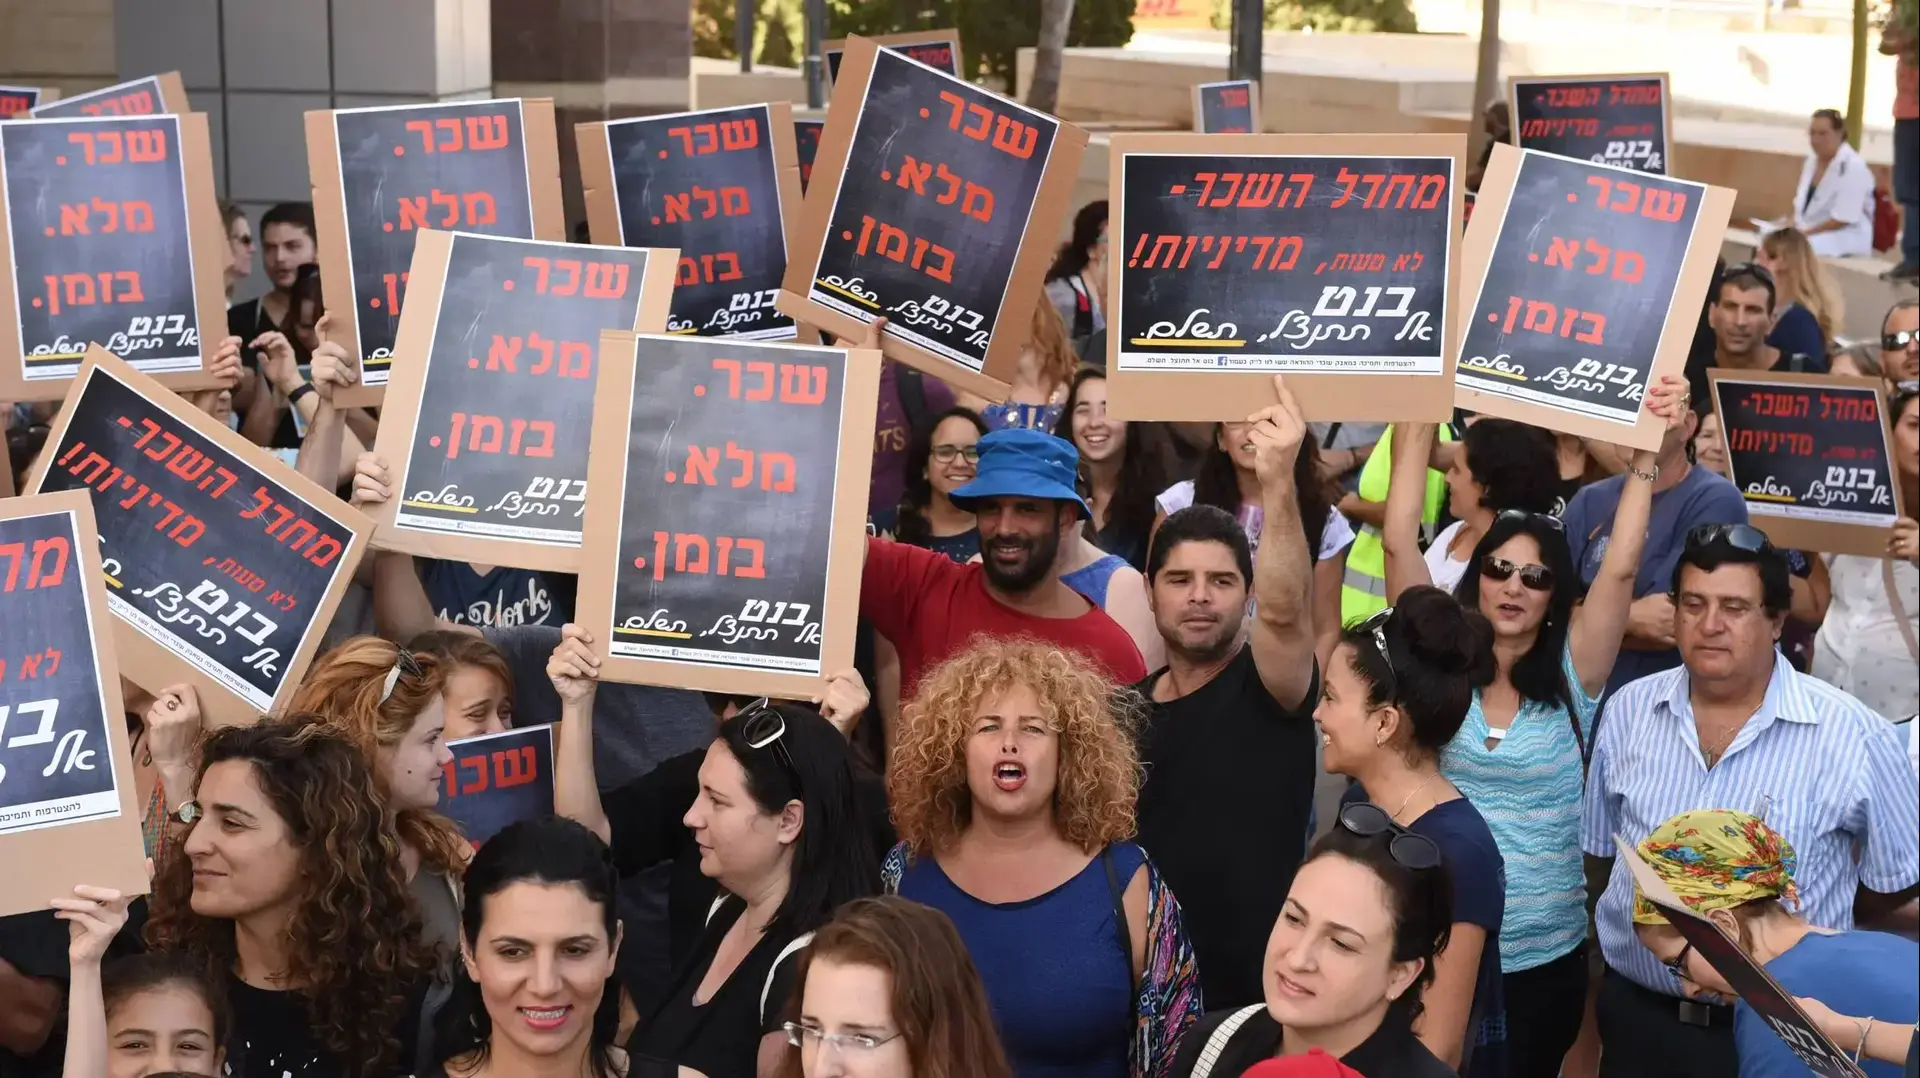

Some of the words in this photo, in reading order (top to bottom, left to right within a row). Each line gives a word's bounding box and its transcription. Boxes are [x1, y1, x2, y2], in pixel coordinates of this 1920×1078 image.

[394, 115, 508, 156] שכר.
[658, 118, 758, 159] שכר.
[919, 90, 1039, 159] שכר.
[57, 129, 166, 165] שכר.
[652, 186, 750, 225] מלא.
[881, 155, 996, 224] מלא.
[1170, 171, 1315, 208] השכר-
[1331, 167, 1446, 209] מחדל
[1567, 175, 1687, 222] שכר.
[45, 197, 156, 236] מלא.
[384, 189, 496, 232] מלא.
[843, 216, 957, 284] בזמן.
[1128, 233, 1304, 270] מדיניות!
[1314, 252, 1386, 276] טעות,
[1392, 252, 1424, 271] לא
[1528, 236, 1646, 283] מלא.
[503, 257, 629, 299] שכר.
[674, 252, 743, 287] בזמ
[32, 270, 144, 315] בזמן.
[729, 288, 780, 312] בנט
[821, 274, 878, 303] תשלם.
[1311, 286, 1416, 317] בנט
[128, 314, 185, 335] בנט
[921, 294, 984, 331] בנט
[1139, 308, 1237, 339] תשלם.
[1256, 309, 1370, 350] תתנצל,
[1395, 311, 1433, 342] אל
[1487, 296, 1607, 345] בזמן.
[468, 332, 592, 379] מלא.
[1571, 358, 1638, 385] בנט
[694, 358, 828, 405] שכר.
[1741, 392, 1810, 418] השכר-
[1820, 391, 1876, 421] מחדל
[430, 413, 555, 459] בזמן.
[874, 426, 906, 452] TS
[117, 416, 239, 500] השכר-
[665, 441, 796, 492] מלא.
[57, 441, 207, 548] מדיניות!
[409, 484, 474, 508] תשלם.
[524, 476, 588, 502] בנט
[1825, 465, 1877, 490] בנט
[1870, 482, 1890, 506] אל
[240, 486, 342, 568] מחדל
[634, 530, 765, 581] בזמן.
[203, 556, 266, 593] טעות,
[186, 579, 278, 647] בנט
[266, 589, 297, 613] לא
[738, 599, 811, 626] בנט
[619, 609, 687, 632] תשלם.
[700, 615, 778, 645] תתנצל,
[794, 622, 820, 645] אל
[18, 647, 62, 680] לא
[243, 648, 281, 679] אל
[43, 729, 96, 777] אל
[0, 810, 31, 822] ותמיכה
[35, 802, 81, 816] להצטרפות
